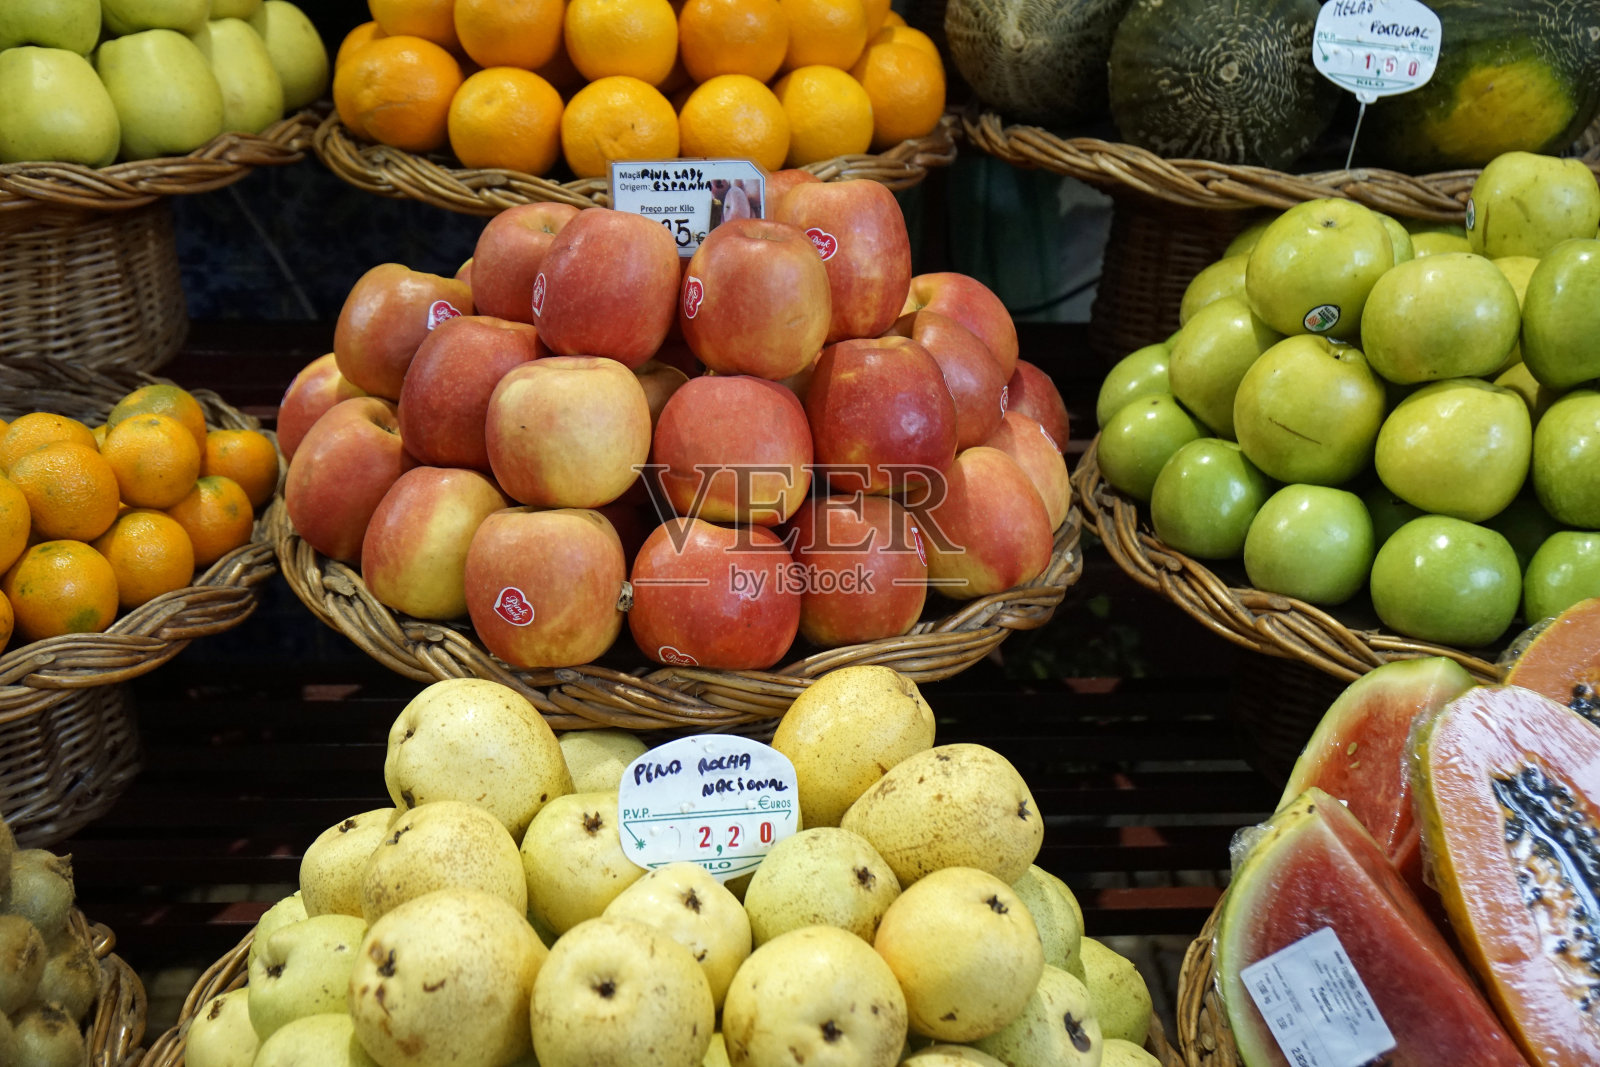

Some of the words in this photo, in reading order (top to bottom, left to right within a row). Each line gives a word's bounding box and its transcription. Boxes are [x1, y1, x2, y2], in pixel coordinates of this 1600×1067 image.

[1370, 21, 1429, 38] PORTUGAL
[1356, 79, 1384, 87] KILO
[620, 183, 650, 192] Origem:
[653, 181, 712, 191] ESPANHA
[640, 205, 662, 213] Preço
[680, 204, 694, 212] Kilo
[811, 234, 830, 248] Pink
[502, 600, 522, 621] Lady
[506, 595, 528, 616] Pink
[697, 753, 751, 776] ROCHA
[702, 778, 788, 797] NACIONAL
[623, 808, 651, 819] P.V.P.
[699, 861, 731, 870] ILO
